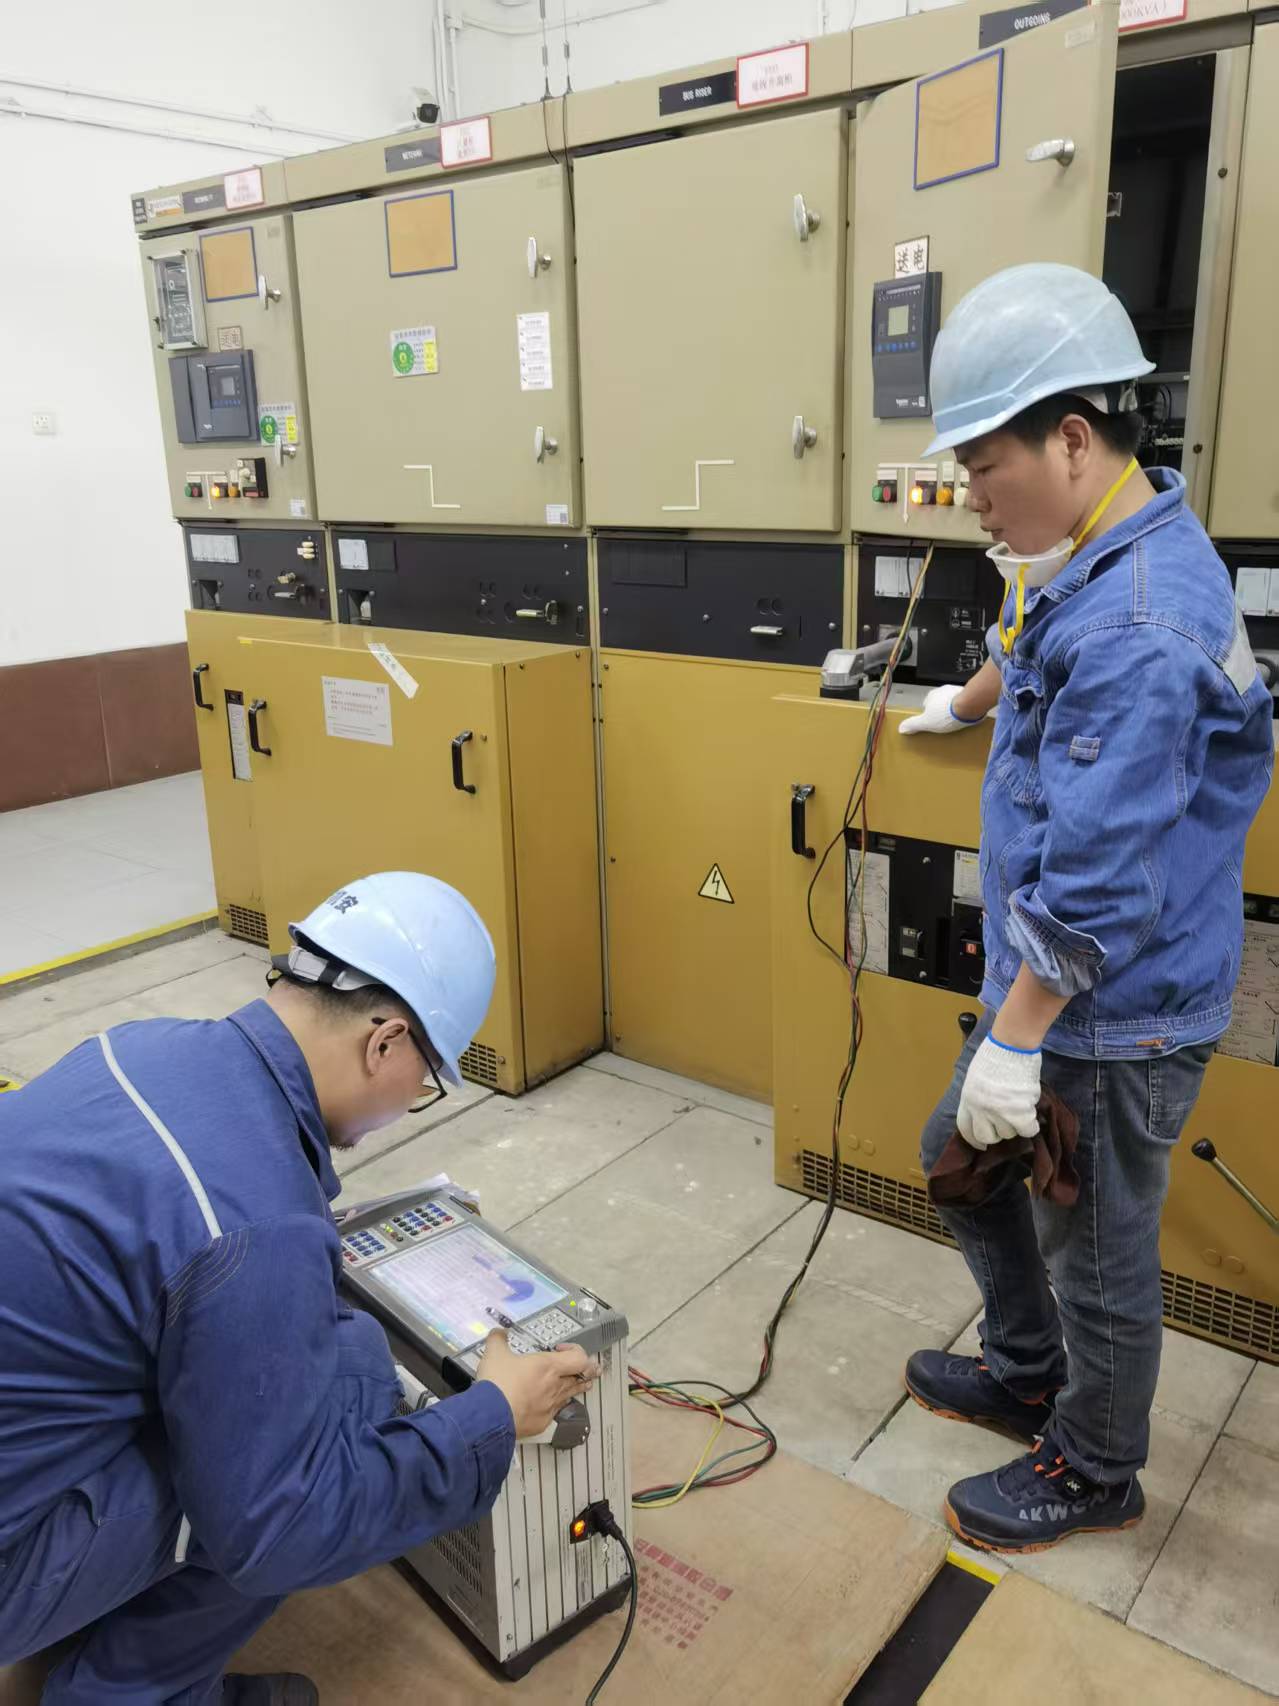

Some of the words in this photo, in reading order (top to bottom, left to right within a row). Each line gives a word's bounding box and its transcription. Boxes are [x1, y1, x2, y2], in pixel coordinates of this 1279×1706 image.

[1014, 12, 1050, 30] OUTGOING
[682, 89, 694, 101] BUS
[695, 86, 712, 98] RISER
